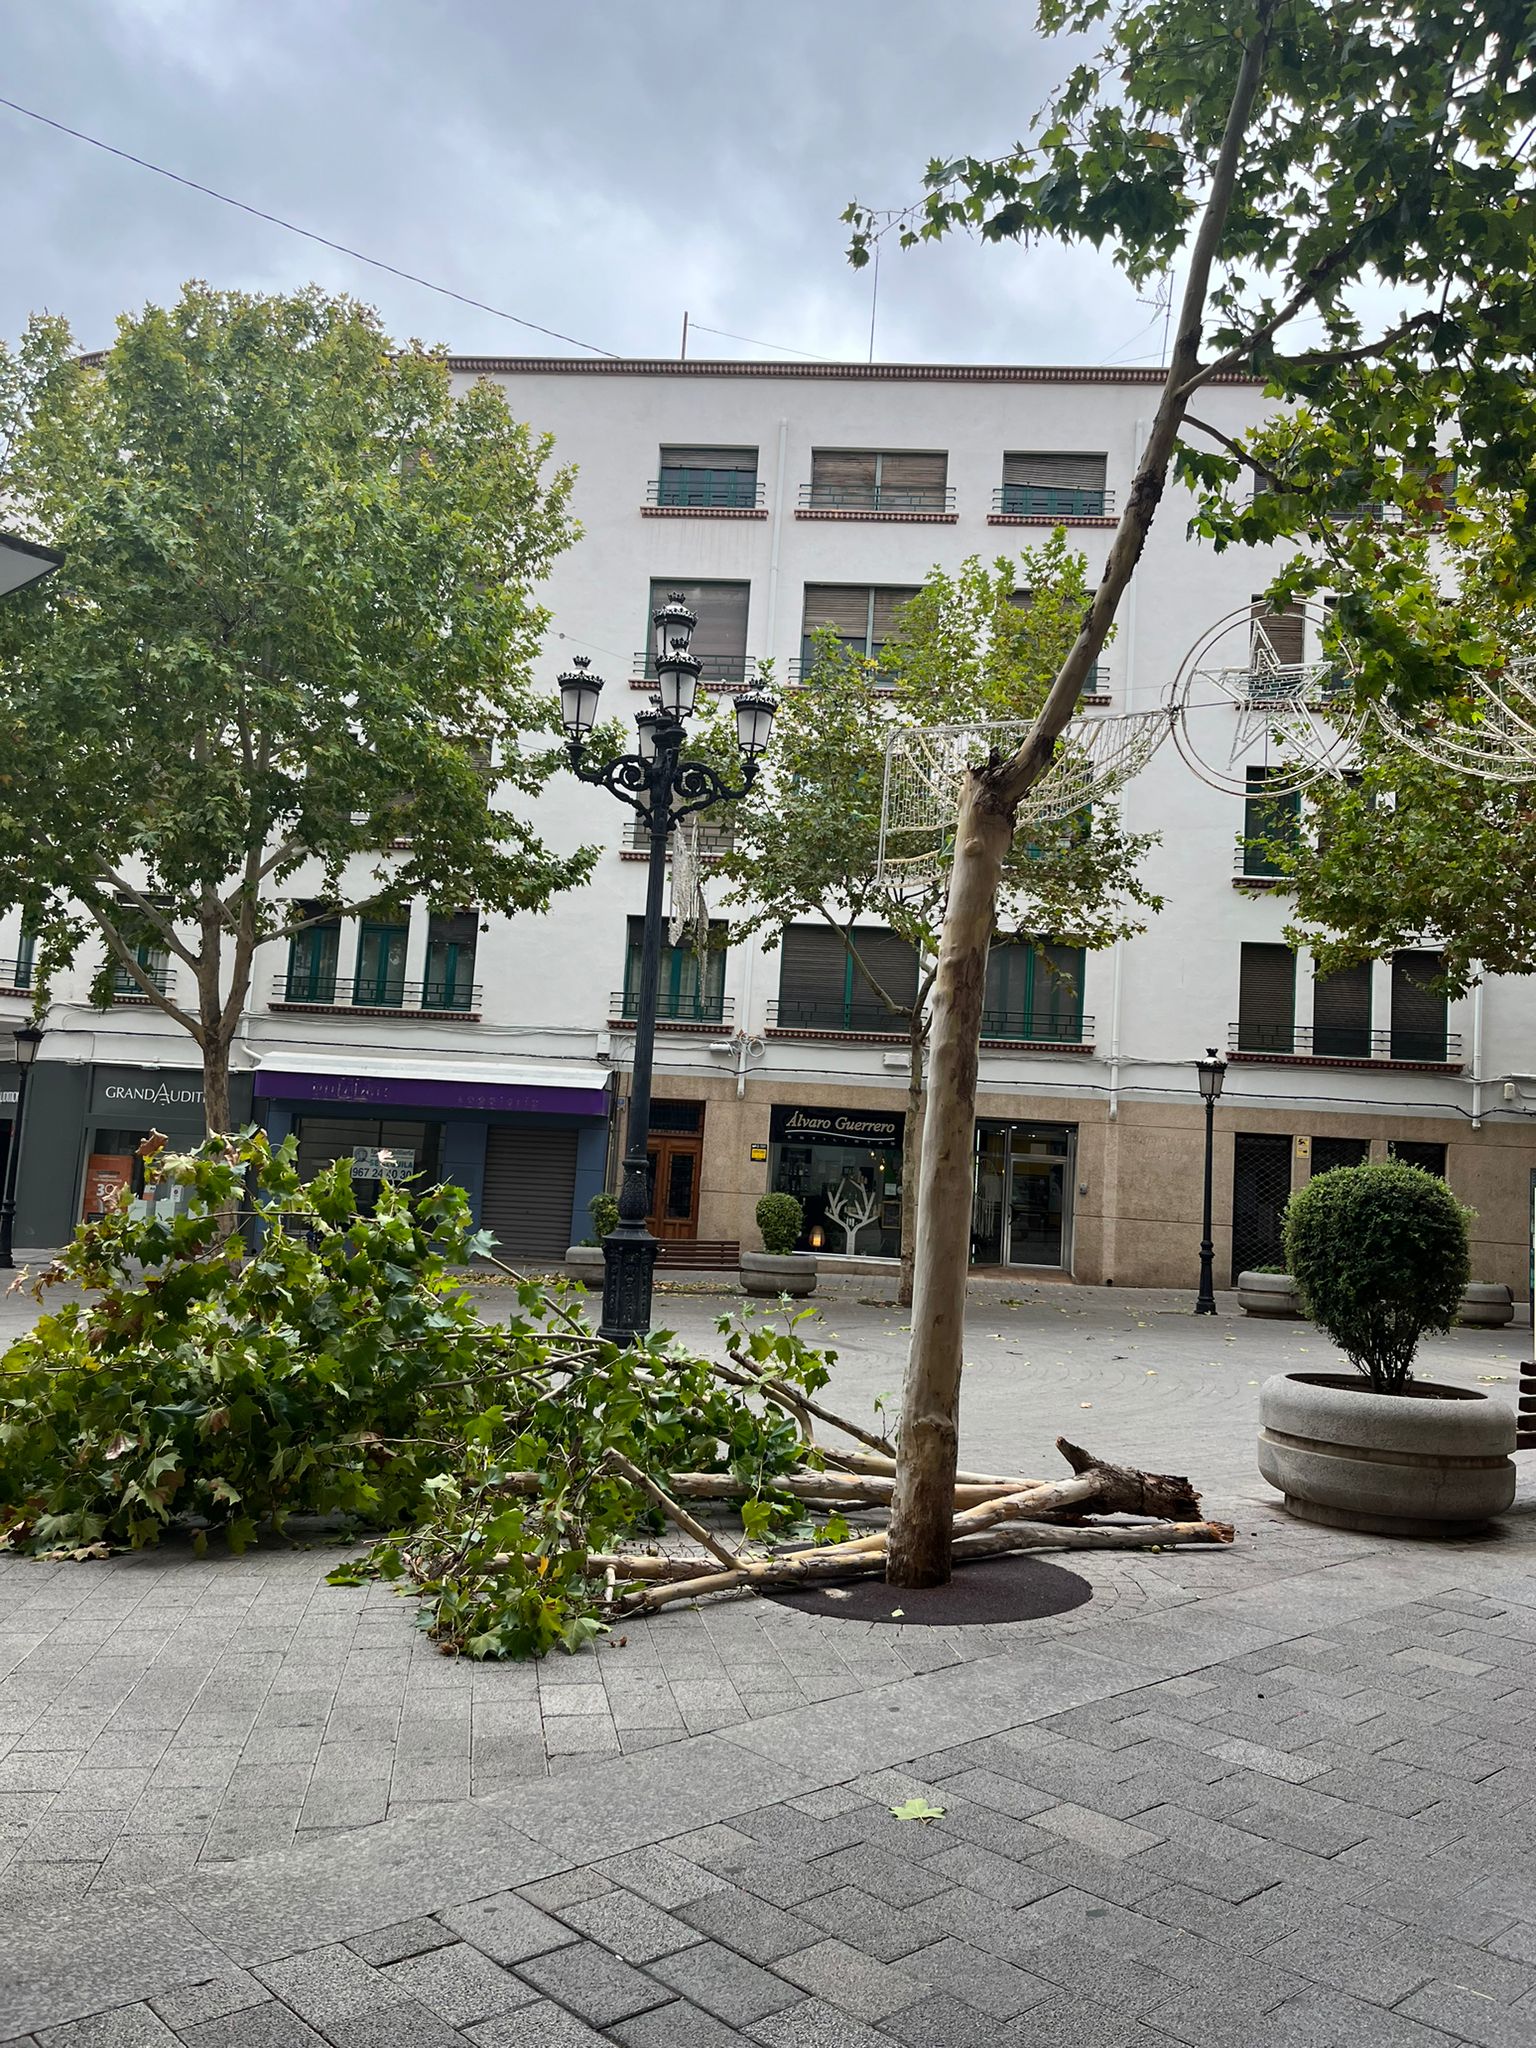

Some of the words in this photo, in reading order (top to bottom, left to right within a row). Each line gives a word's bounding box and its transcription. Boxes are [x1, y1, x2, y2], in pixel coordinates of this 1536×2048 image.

[786, 1110, 831, 1129] Álvaro
[834, 1116, 896, 1133] Guerrero
[352, 1167, 370, 1177] 967
[371, 1168, 383, 1178] 24
